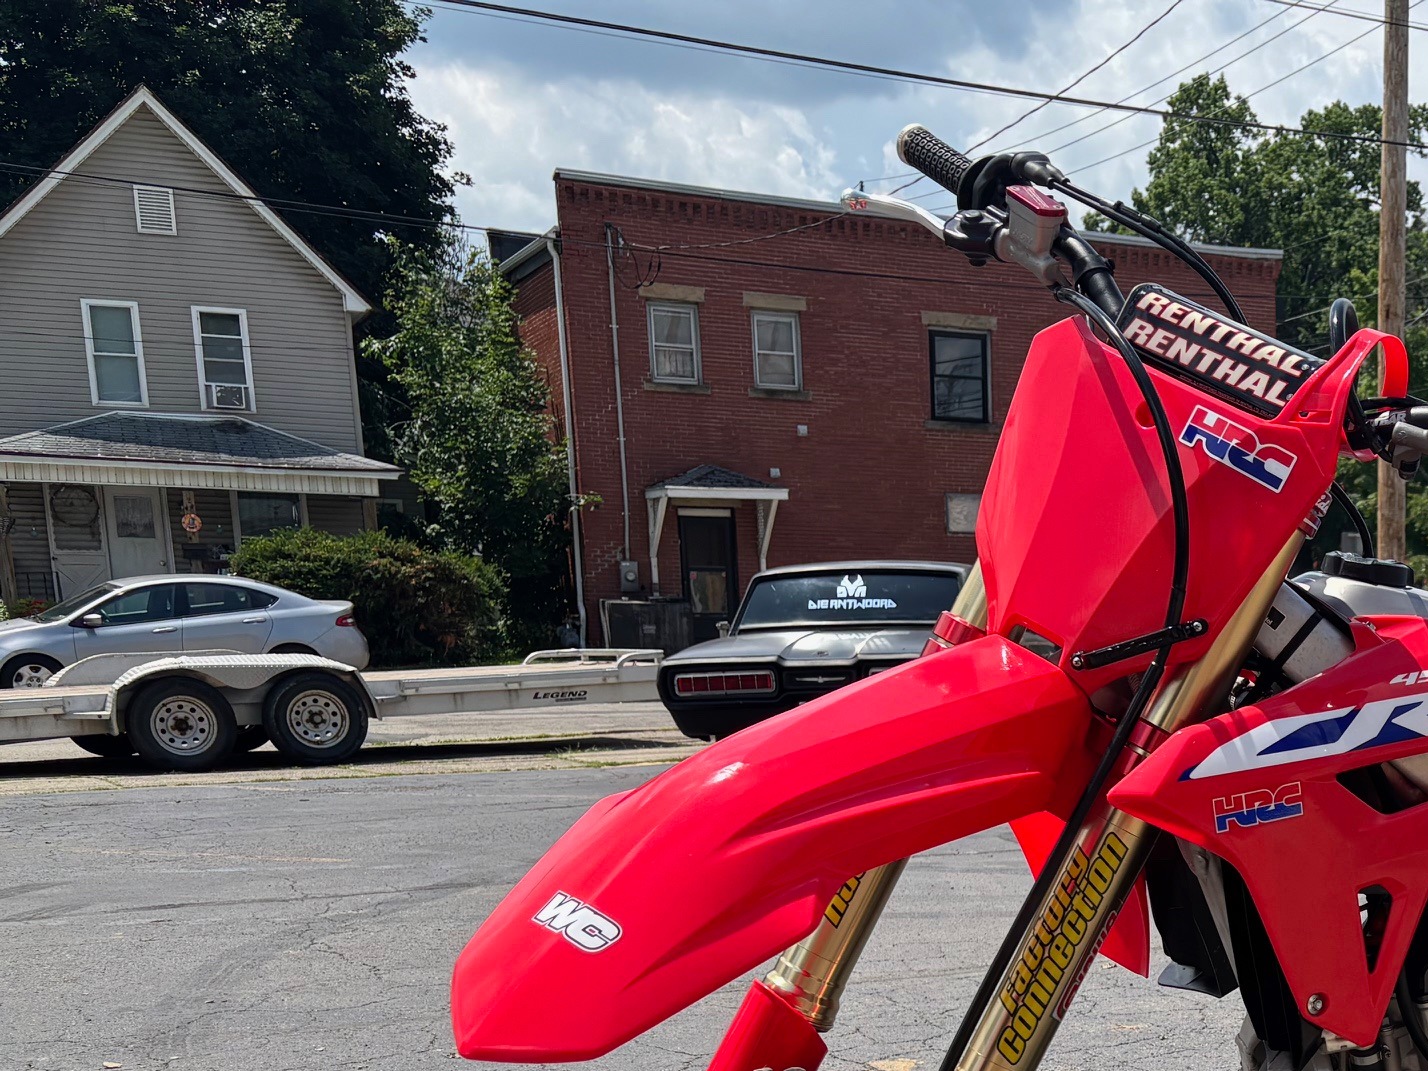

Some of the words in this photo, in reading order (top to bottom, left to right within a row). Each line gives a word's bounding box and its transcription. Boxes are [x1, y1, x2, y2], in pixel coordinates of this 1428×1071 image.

[1123, 317, 1289, 407] RENTHAL
[1136, 292, 1304, 377] RENTHAL
[1178, 404, 1297, 493] HRC
[808, 599, 829, 610] DIE
[829, 598, 897, 610] ANTWOORD
[532, 690, 588, 700] LEGEND
[1213, 782, 1304, 834] HRC
[531, 890, 623, 953] WC
